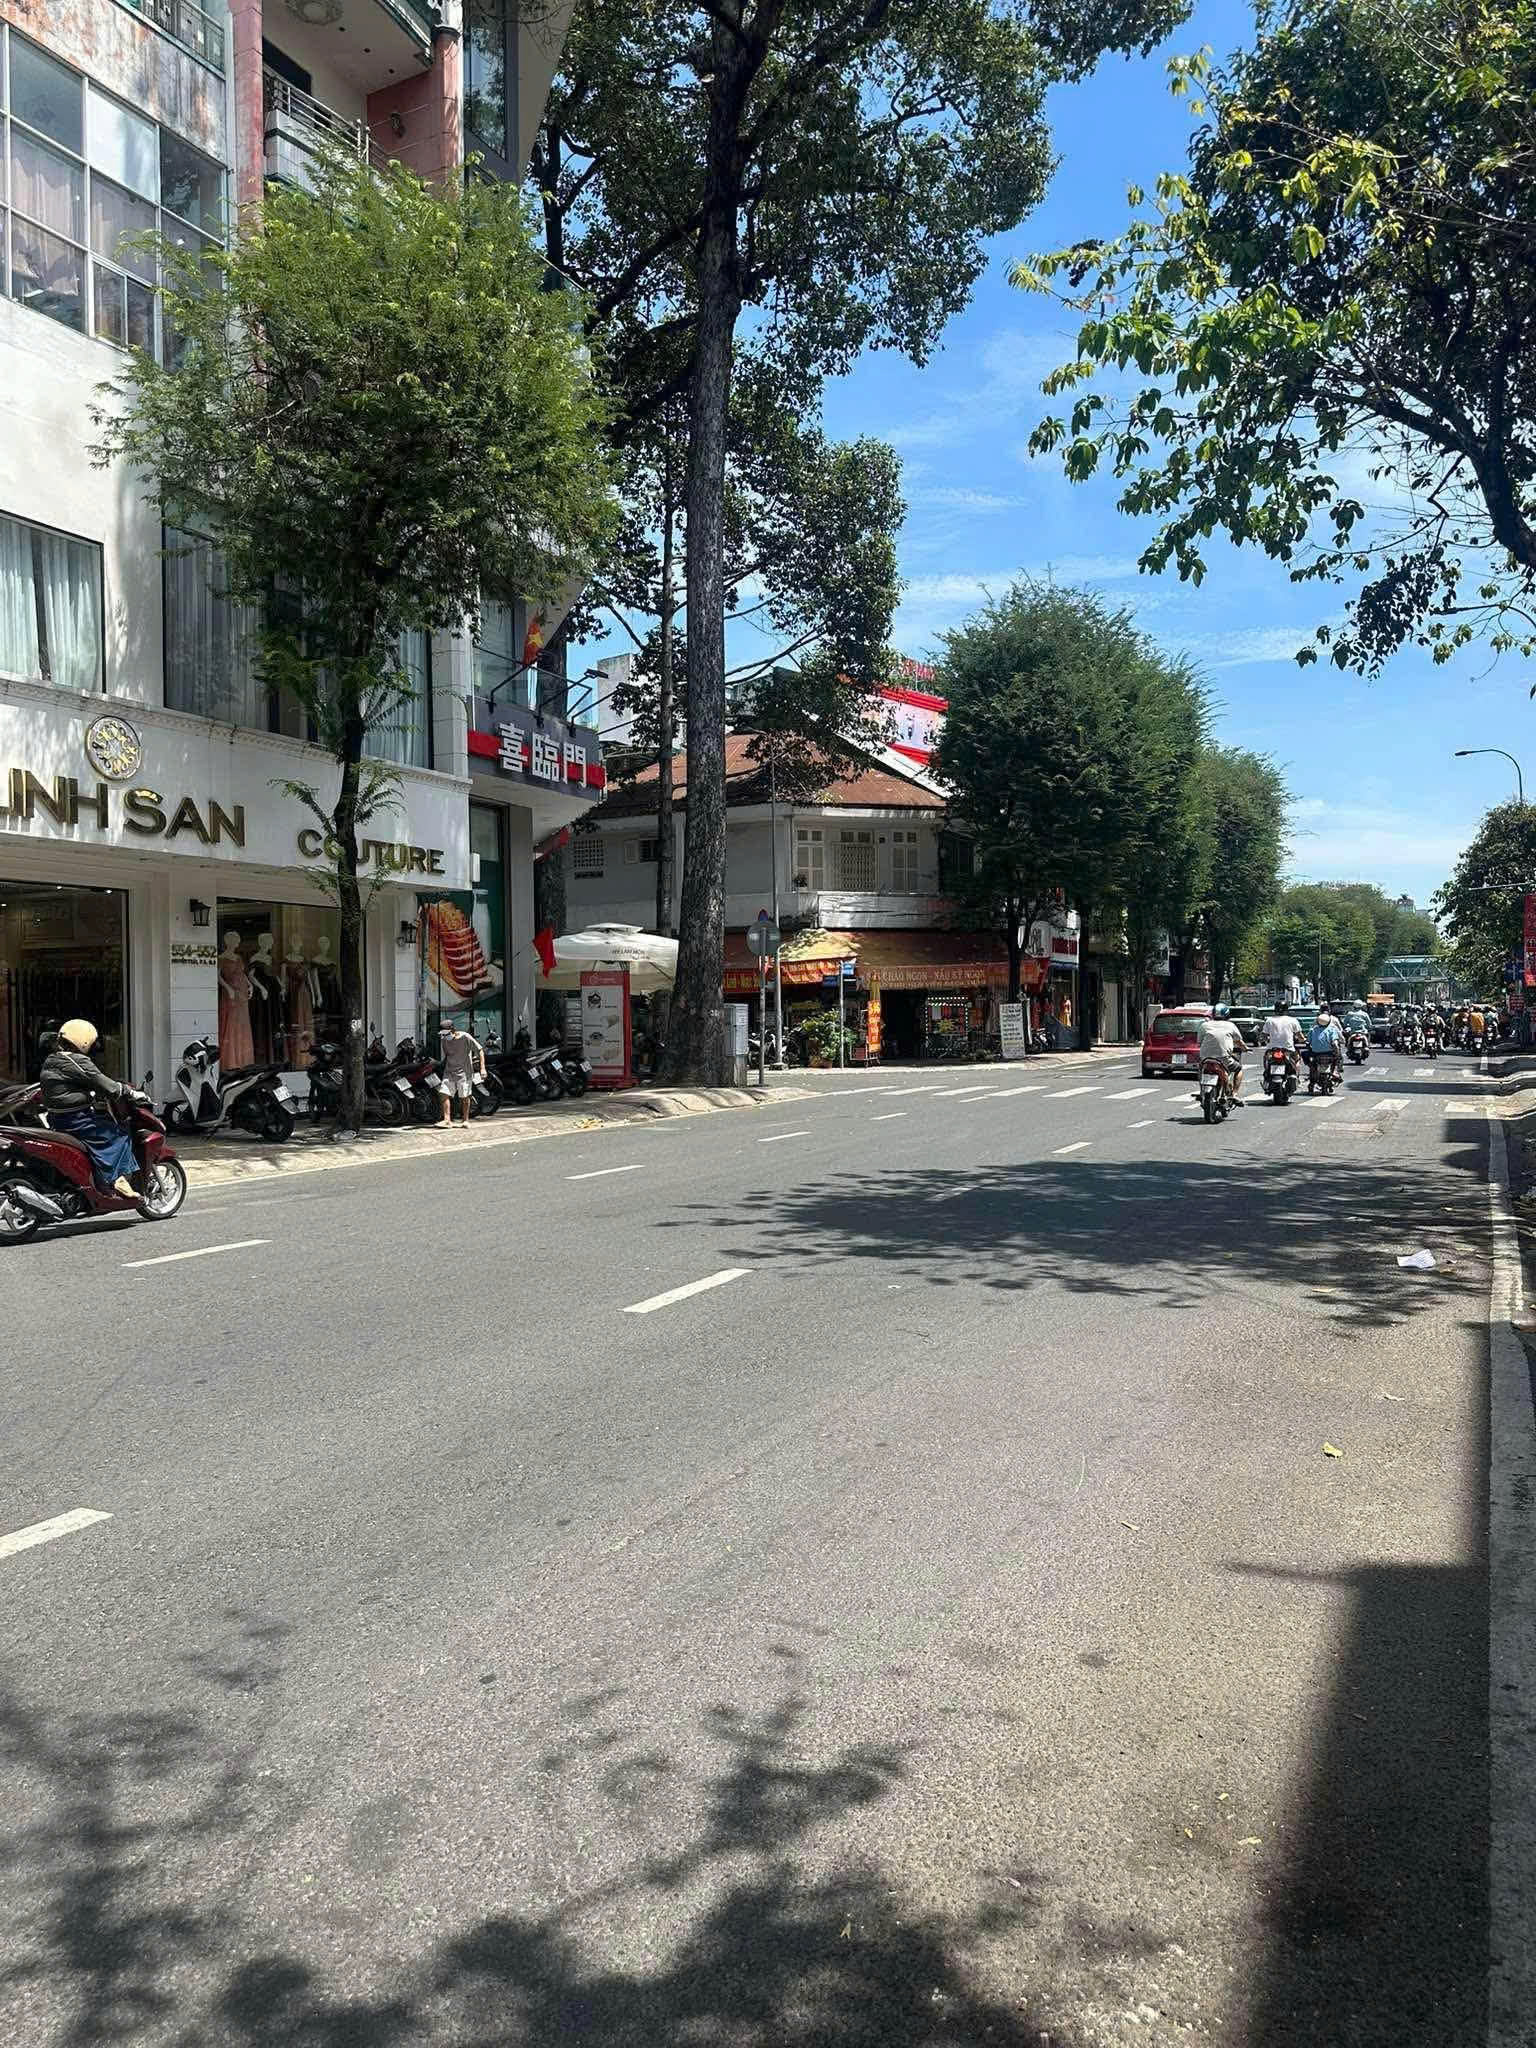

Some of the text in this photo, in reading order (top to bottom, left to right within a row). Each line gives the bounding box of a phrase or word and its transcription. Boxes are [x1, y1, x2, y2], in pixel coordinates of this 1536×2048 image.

[498, 722, 587, 788] 喜臨門
[0, 767, 245, 848] INH SAN
